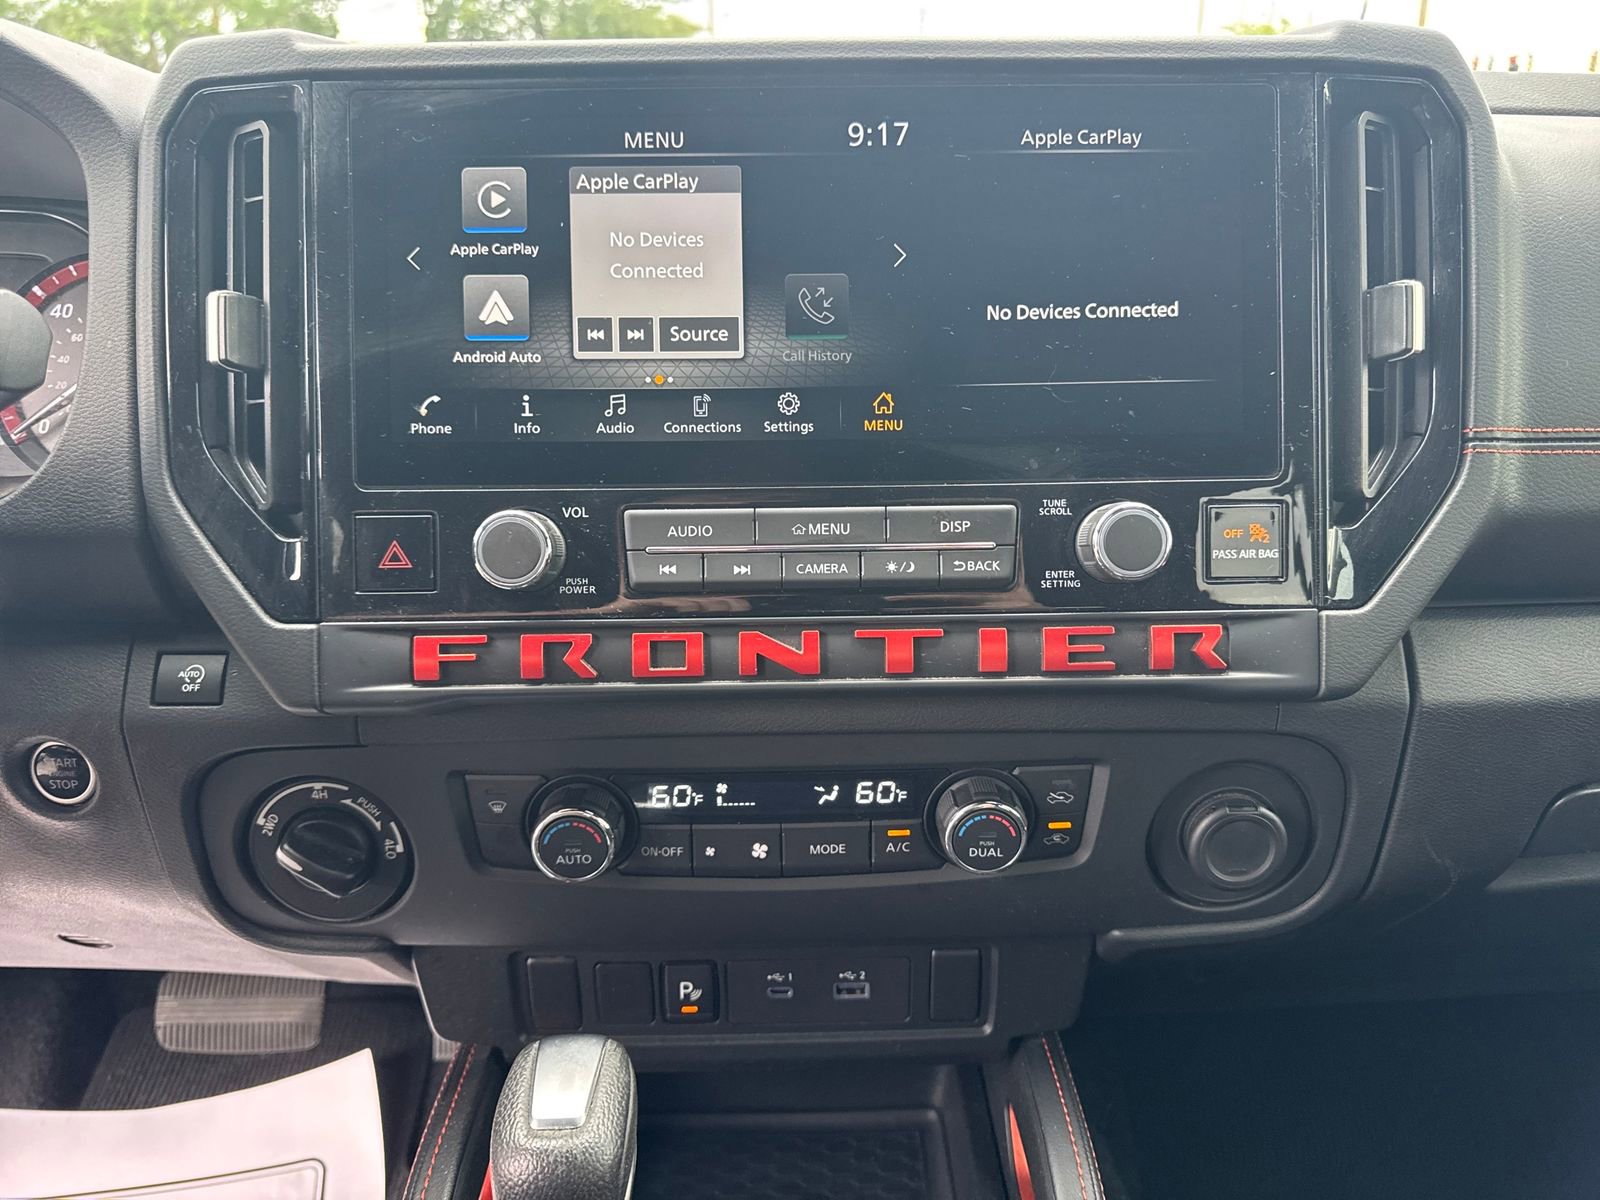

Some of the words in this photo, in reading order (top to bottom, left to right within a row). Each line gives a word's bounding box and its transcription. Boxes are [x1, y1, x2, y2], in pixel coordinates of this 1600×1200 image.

[624, 132, 684, 149] MENU
[848, 121, 909, 148] 9:17
[1021, 130, 1073, 148] Apple
[1077, 129, 1142, 148] CarPlay
[577, 173, 628, 192] Apple
[633, 172, 699, 191] CarPlay
[610, 233, 634, 248] No
[639, 232, 704, 248] Devices
[450, 243, 489, 258] Apple
[492, 242, 539, 257] CarPlay
[610, 263, 704, 279] Connected
[50, 303, 73, 319] 40
[986, 305, 1011, 320] No
[1016, 303, 1081, 320] Devices
[1085, 301, 1179, 319] Connected
[71, 333, 83, 342] 60
[669, 326, 729, 342] Source
[57, 355, 70, 364] 40
[453, 350, 505, 364] Android
[508, 350, 542, 364] Auto
[782, 349, 806, 362] Call
[809, 348, 852, 364] History
[55, 381, 67, 390] 20
[38, 419, 49, 434] 0
[410, 422, 452, 435] Phone
[513, 422, 541, 435] Info
[596, 422, 635, 435] Audio
[664, 421, 742, 434] Connections
[764, 420, 814, 436] Settings
[864, 420, 903, 431] MENU
[1042, 499, 1067, 507] TUNE
[562, 506, 589, 519] VOL
[1039, 507, 1072, 516] SCROLL
[667, 524, 713, 538] AUDIO
[809, 522, 851, 536] MENU
[940, 519, 971, 533] DISP
[1223, 528, 1244, 539] OFF
[1212, 549, 1238, 559] PASS
[1239, 549, 1257, 559] AIR
[1258, 549, 1279, 558] BAG
[796, 562, 848, 576] CAMERA
[967, 559, 1001, 572] BACK
[1045, 570, 1075, 579] ENTER
[566, 578, 589, 586] PUSH
[1040, 580, 1080, 588] SETTING
[559, 585, 597, 594] POWER
[413, 623, 1228, 681] FRONTIER
[178, 670, 200, 678] AUTO
[181, 683, 201, 692] OFF
[49, 757, 77, 768] TART
[49, 779, 78, 789] STOP
[311, 790, 328, 799] 4H
[357, 797, 381, 817] PUSH
[262, 813, 279, 837] 2WD
[384, 838, 397, 860] 4LO
[809, 844, 847, 855] MODE
[886, 842, 911, 852] A/C
[969, 848, 1003, 857] DUAL
[556, 854, 592, 864] AUTO
[787, 973, 793, 981] 1
[859, 971, 866, 980] 2
